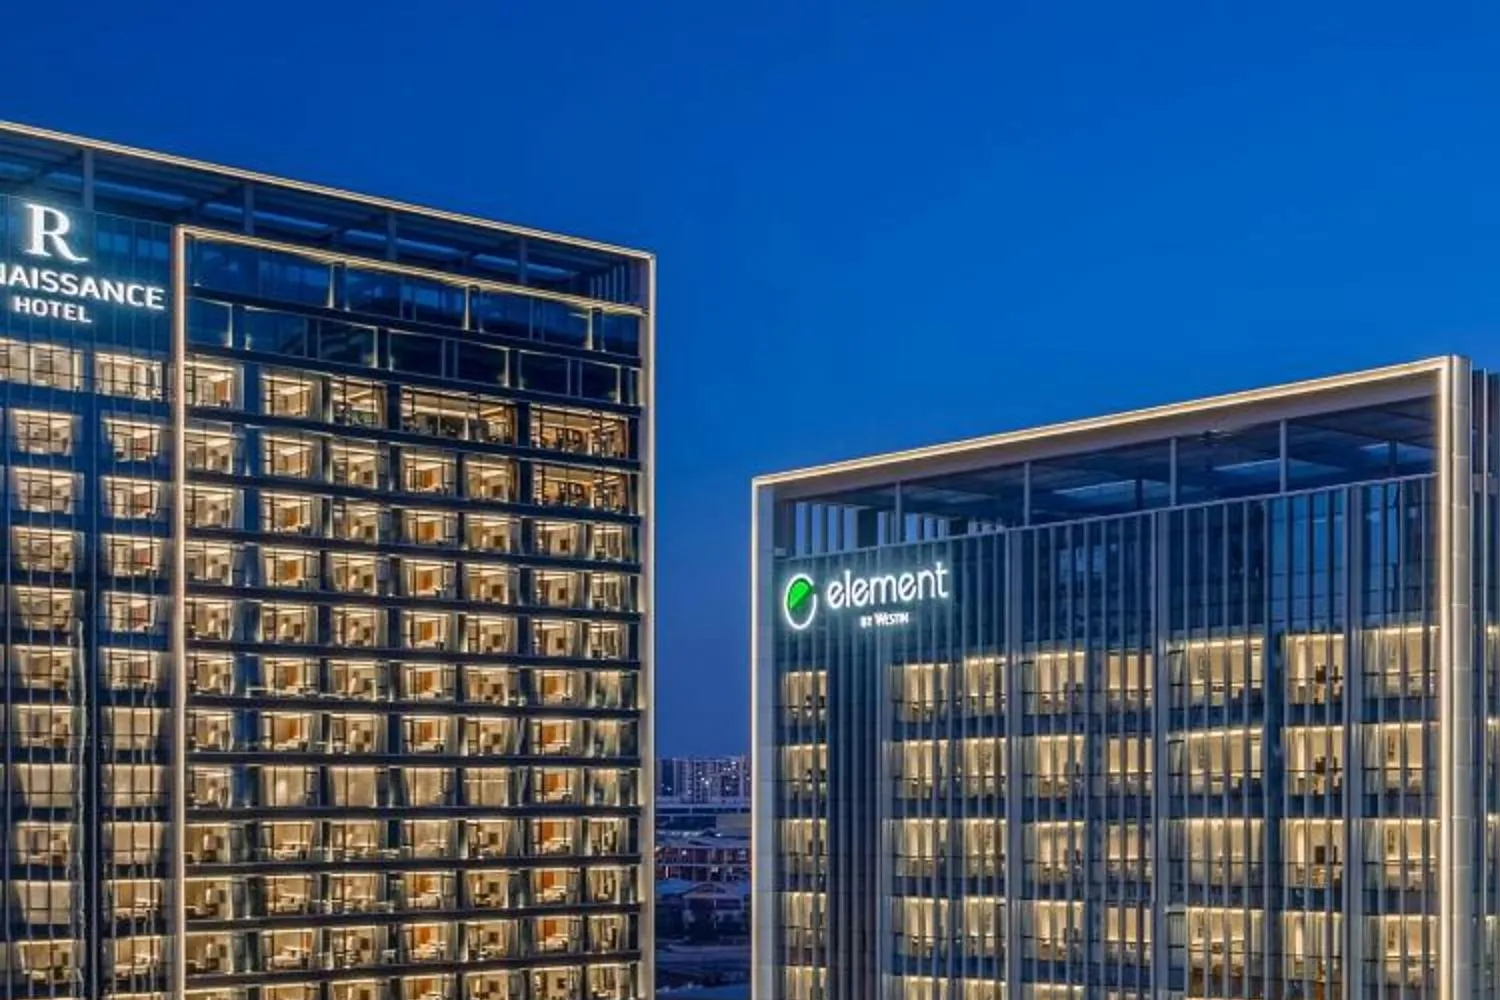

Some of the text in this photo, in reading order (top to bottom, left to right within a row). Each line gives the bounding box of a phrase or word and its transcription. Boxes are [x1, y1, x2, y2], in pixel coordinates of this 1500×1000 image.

[23, 203, 89, 263] R
[13, 295, 92, 324] HOTEL
[827, 561, 949, 609] element
